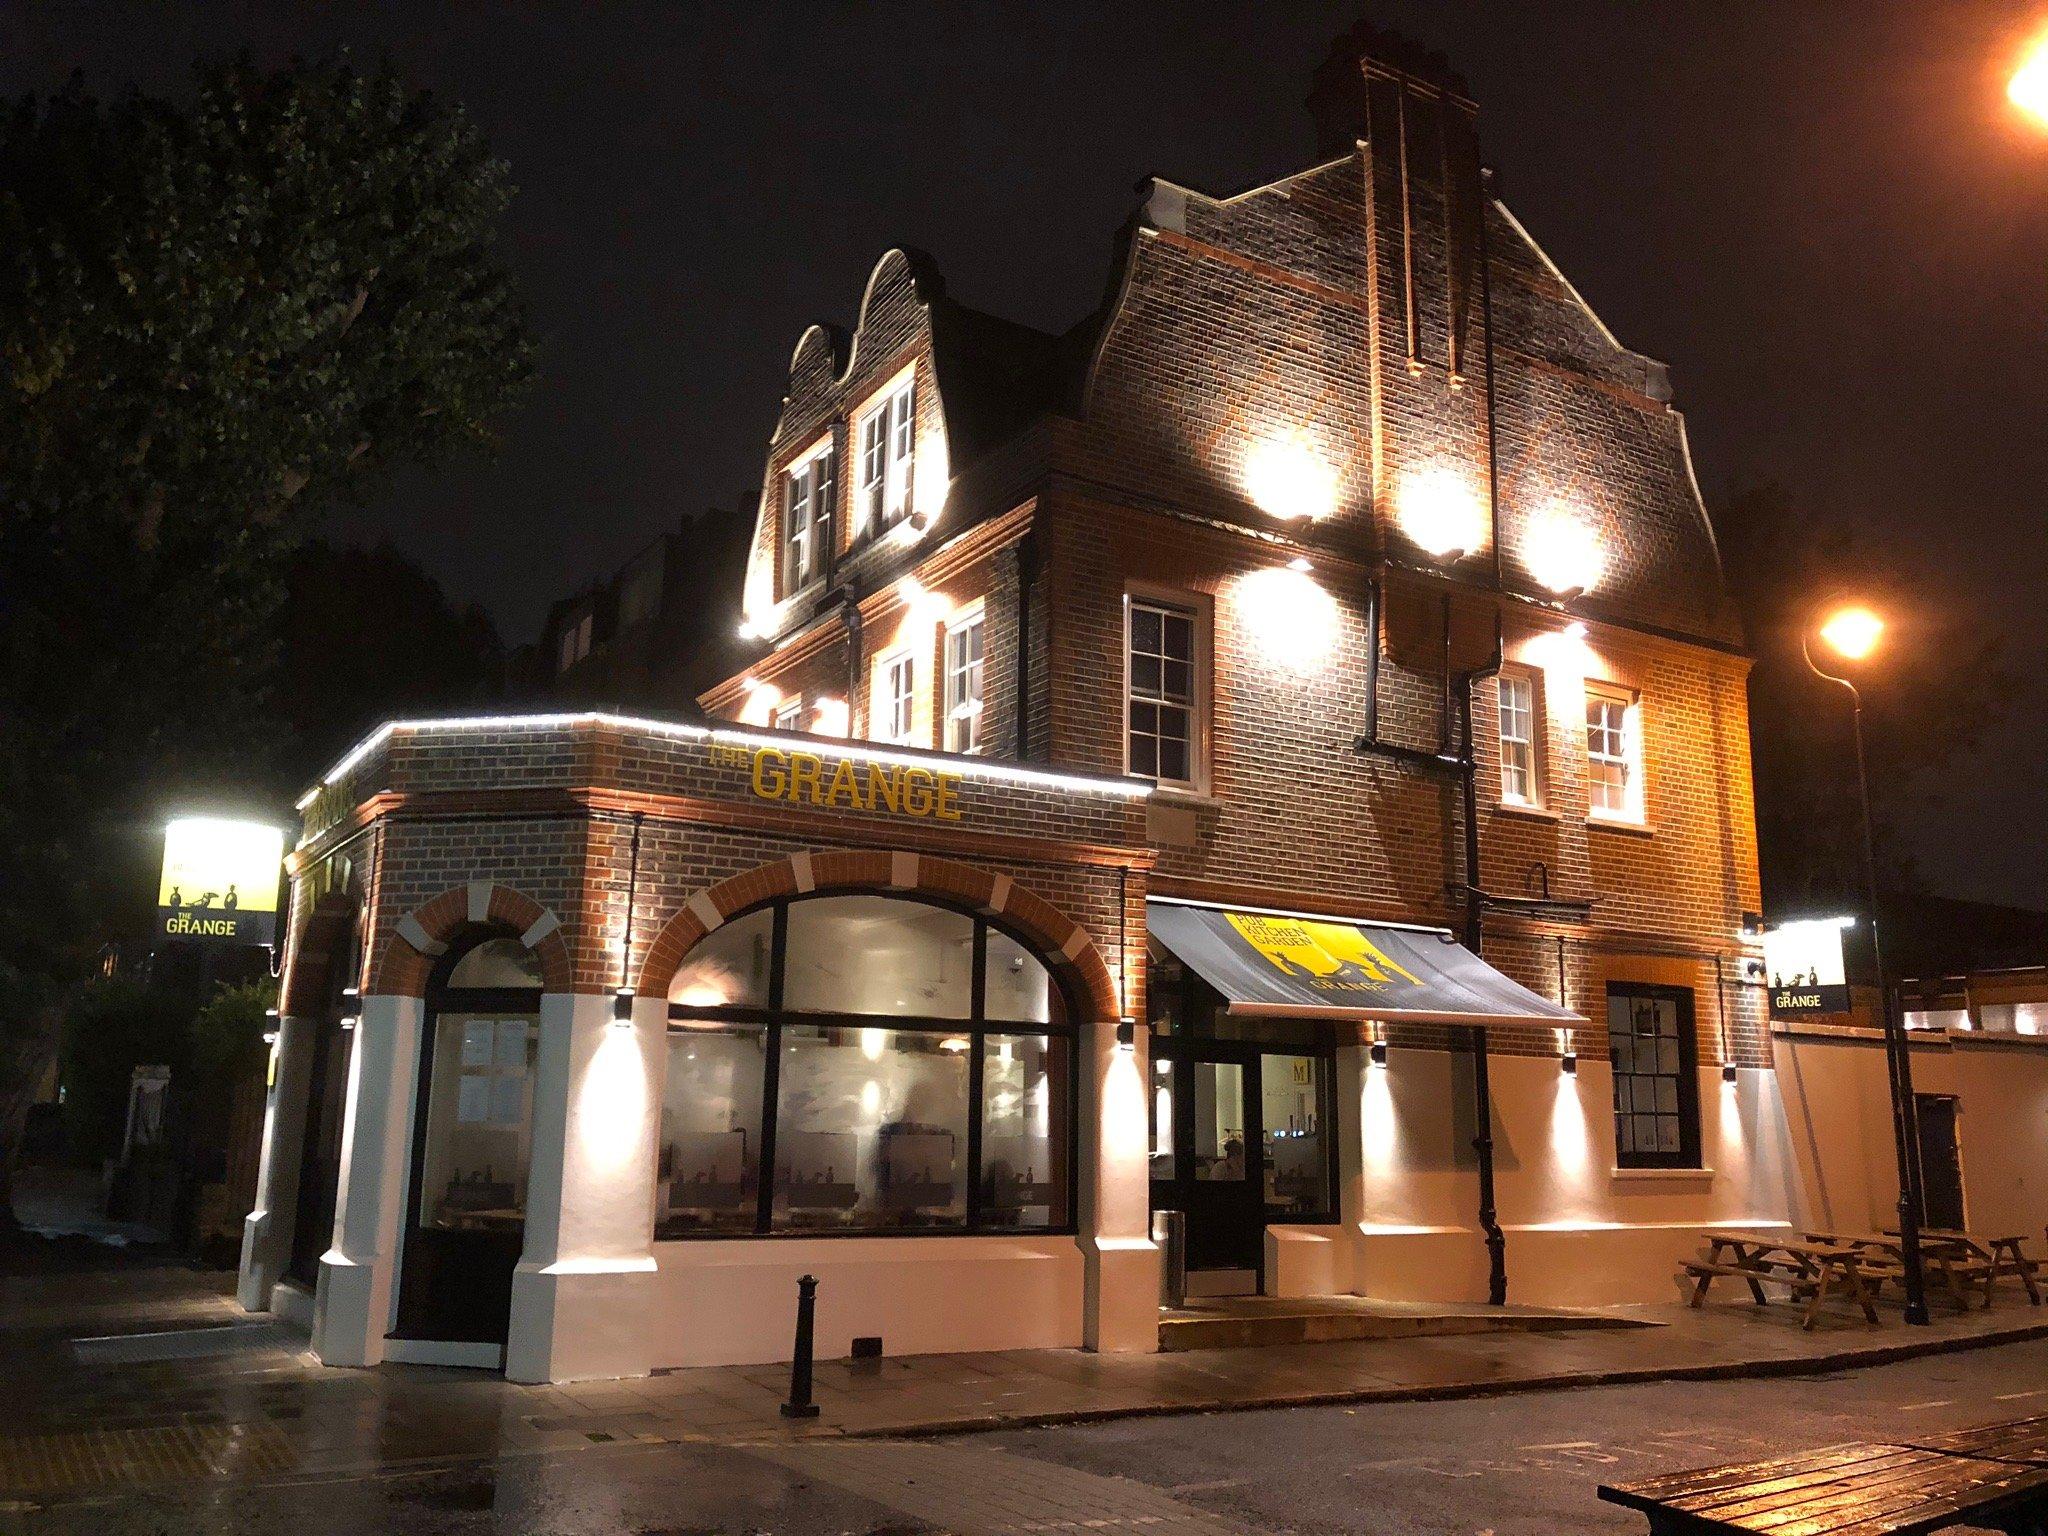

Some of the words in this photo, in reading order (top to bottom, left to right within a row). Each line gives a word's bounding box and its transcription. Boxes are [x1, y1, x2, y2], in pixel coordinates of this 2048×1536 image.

[709, 744, 749, 769] THE
[752, 748, 962, 820] GRANGE
[1236, 914, 1267, 926] PUB
[166, 918, 236, 936] GRANGE
[1244, 925, 1308, 937] KITCHEN
[1253, 935, 1313, 947] GARDEN
[1309, 980, 1389, 992] GRANGE
[1776, 995, 1821, 1008] GRANGE
